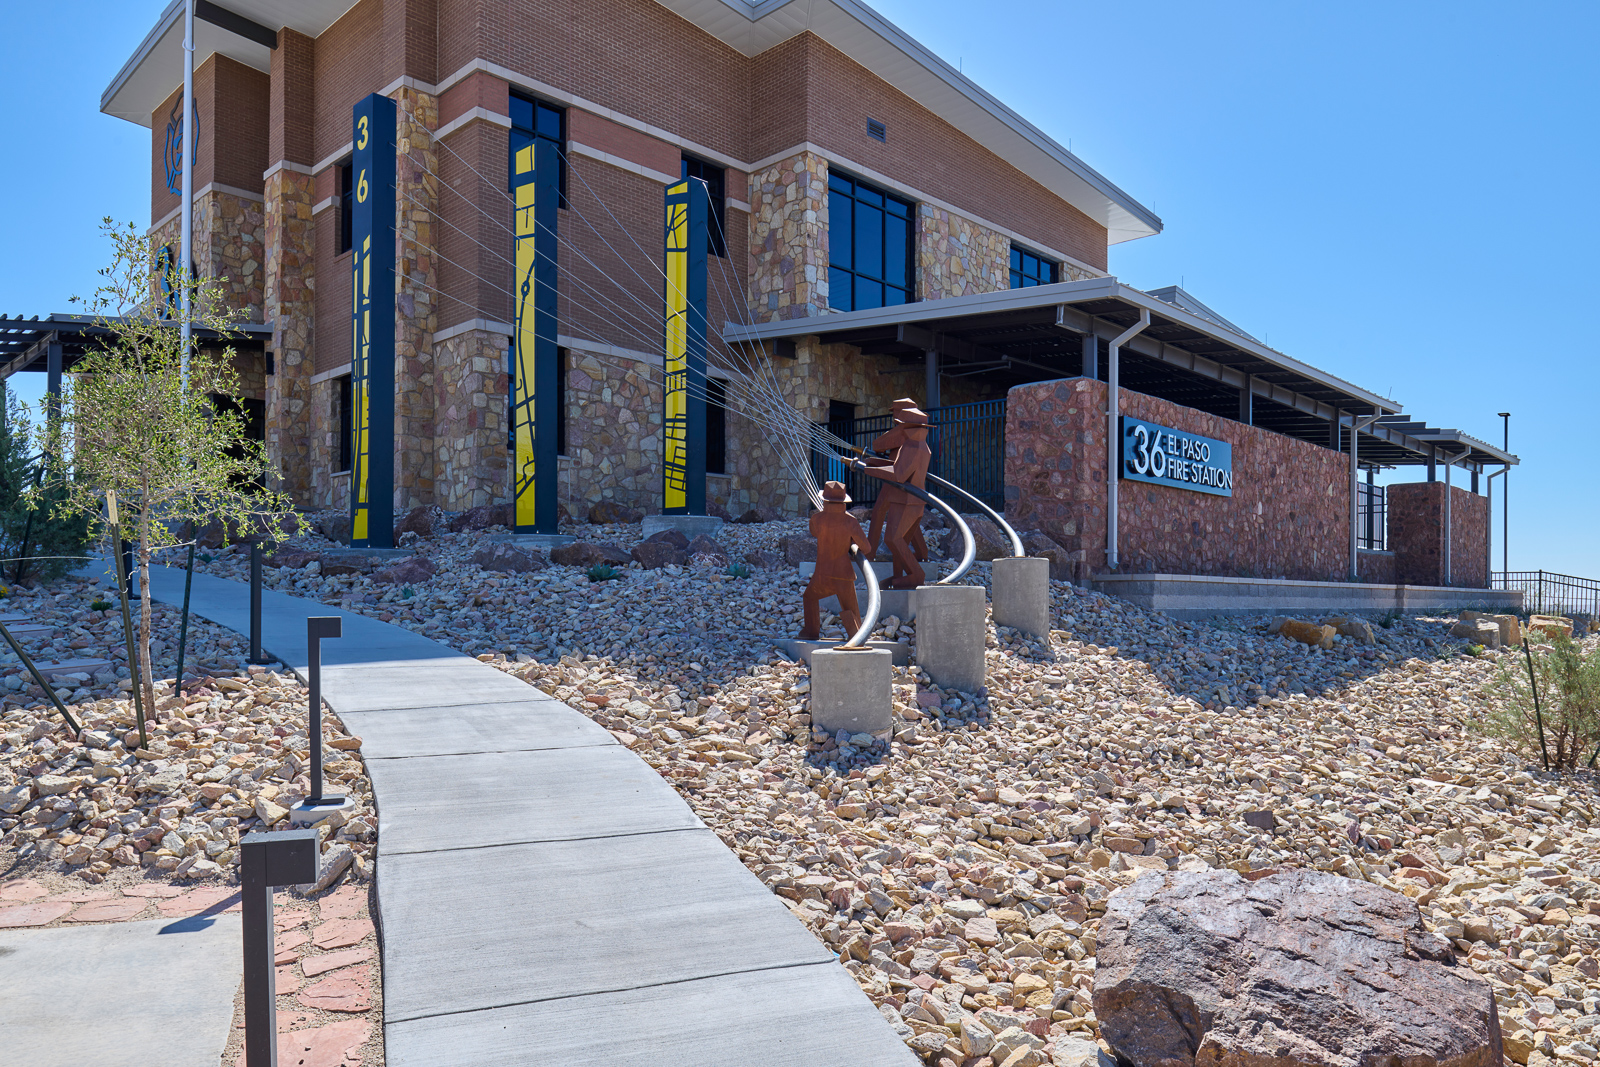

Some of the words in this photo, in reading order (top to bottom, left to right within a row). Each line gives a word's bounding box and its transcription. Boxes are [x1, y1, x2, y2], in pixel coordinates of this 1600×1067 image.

[1134, 424, 1166, 477] 36
[1168, 434, 1180, 456] EL
[1182, 437, 1210, 463] PASO
[1168, 457, 1189, 481] FIRE
[1191, 463, 1233, 489] STATION
